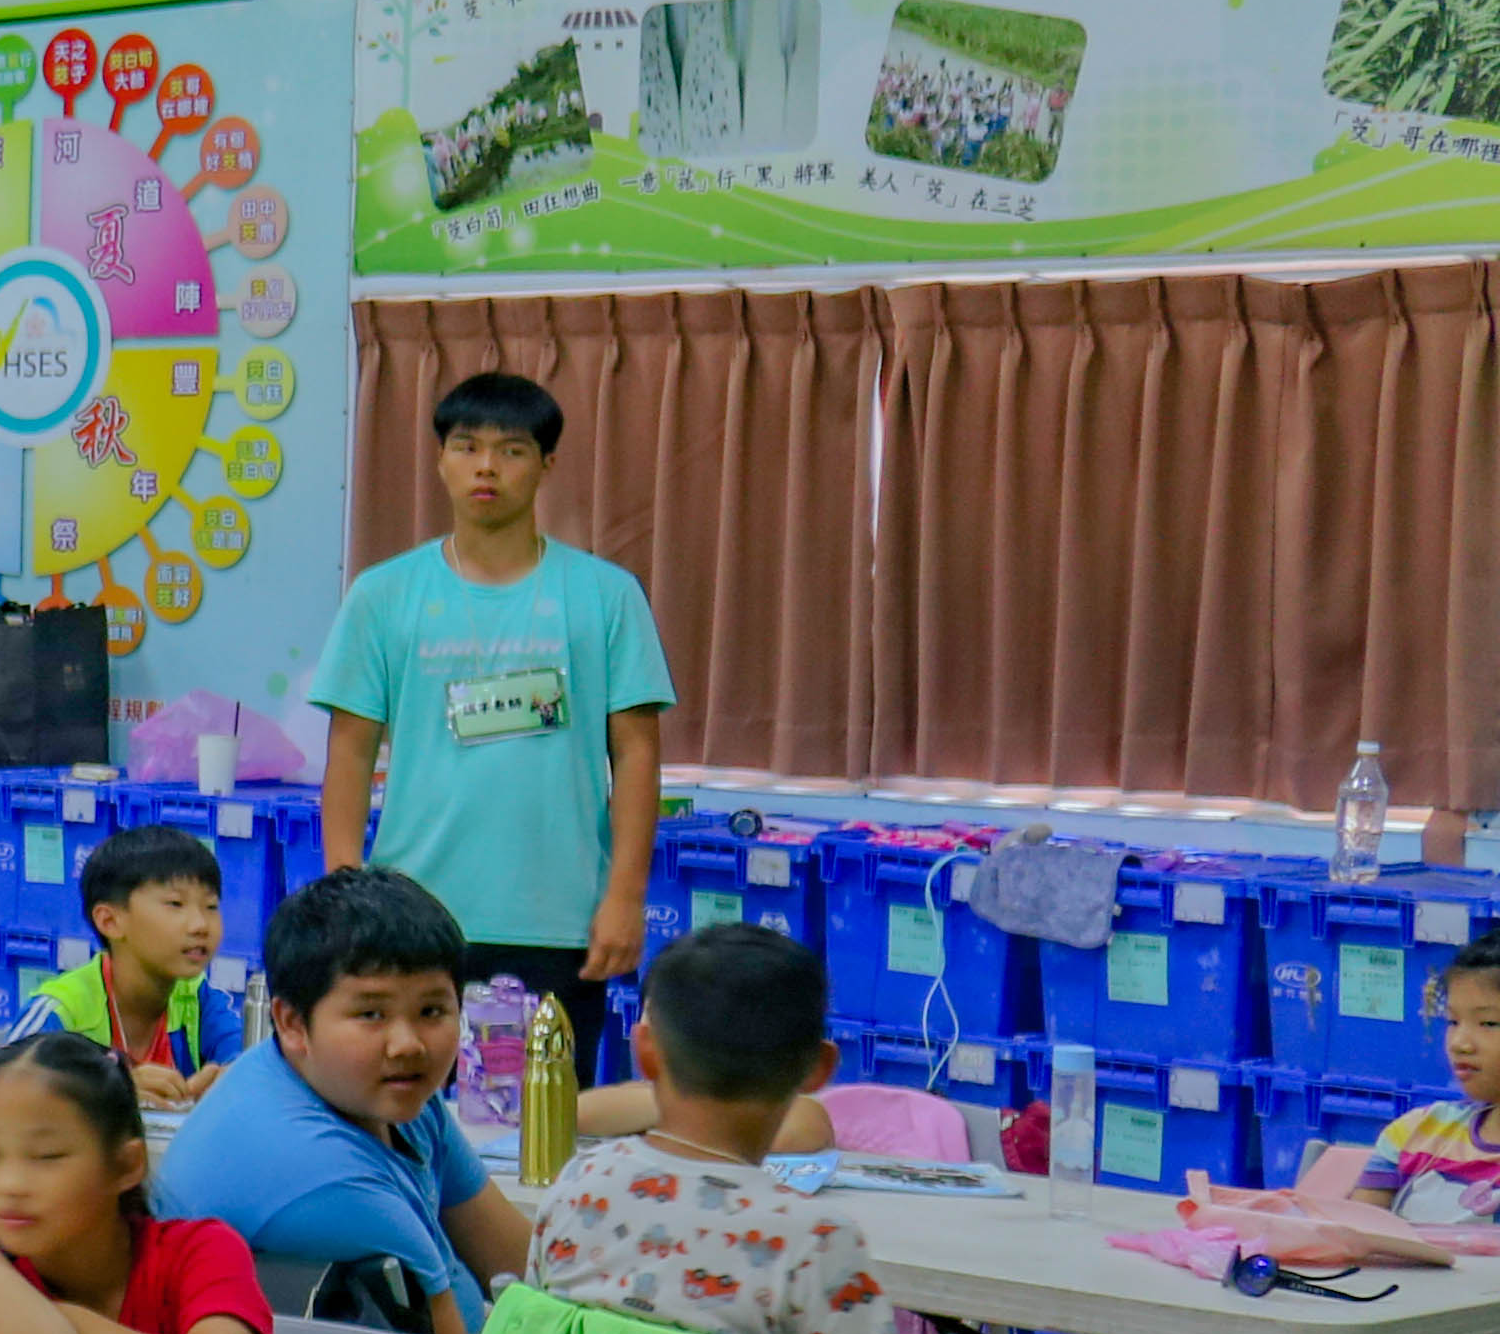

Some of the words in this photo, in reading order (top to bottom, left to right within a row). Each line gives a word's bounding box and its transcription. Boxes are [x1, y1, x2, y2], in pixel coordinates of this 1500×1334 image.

[87, 205, 135, 284] 夏
[3, 350, 69, 379] HSES
[72, 396, 138, 469] 秋
